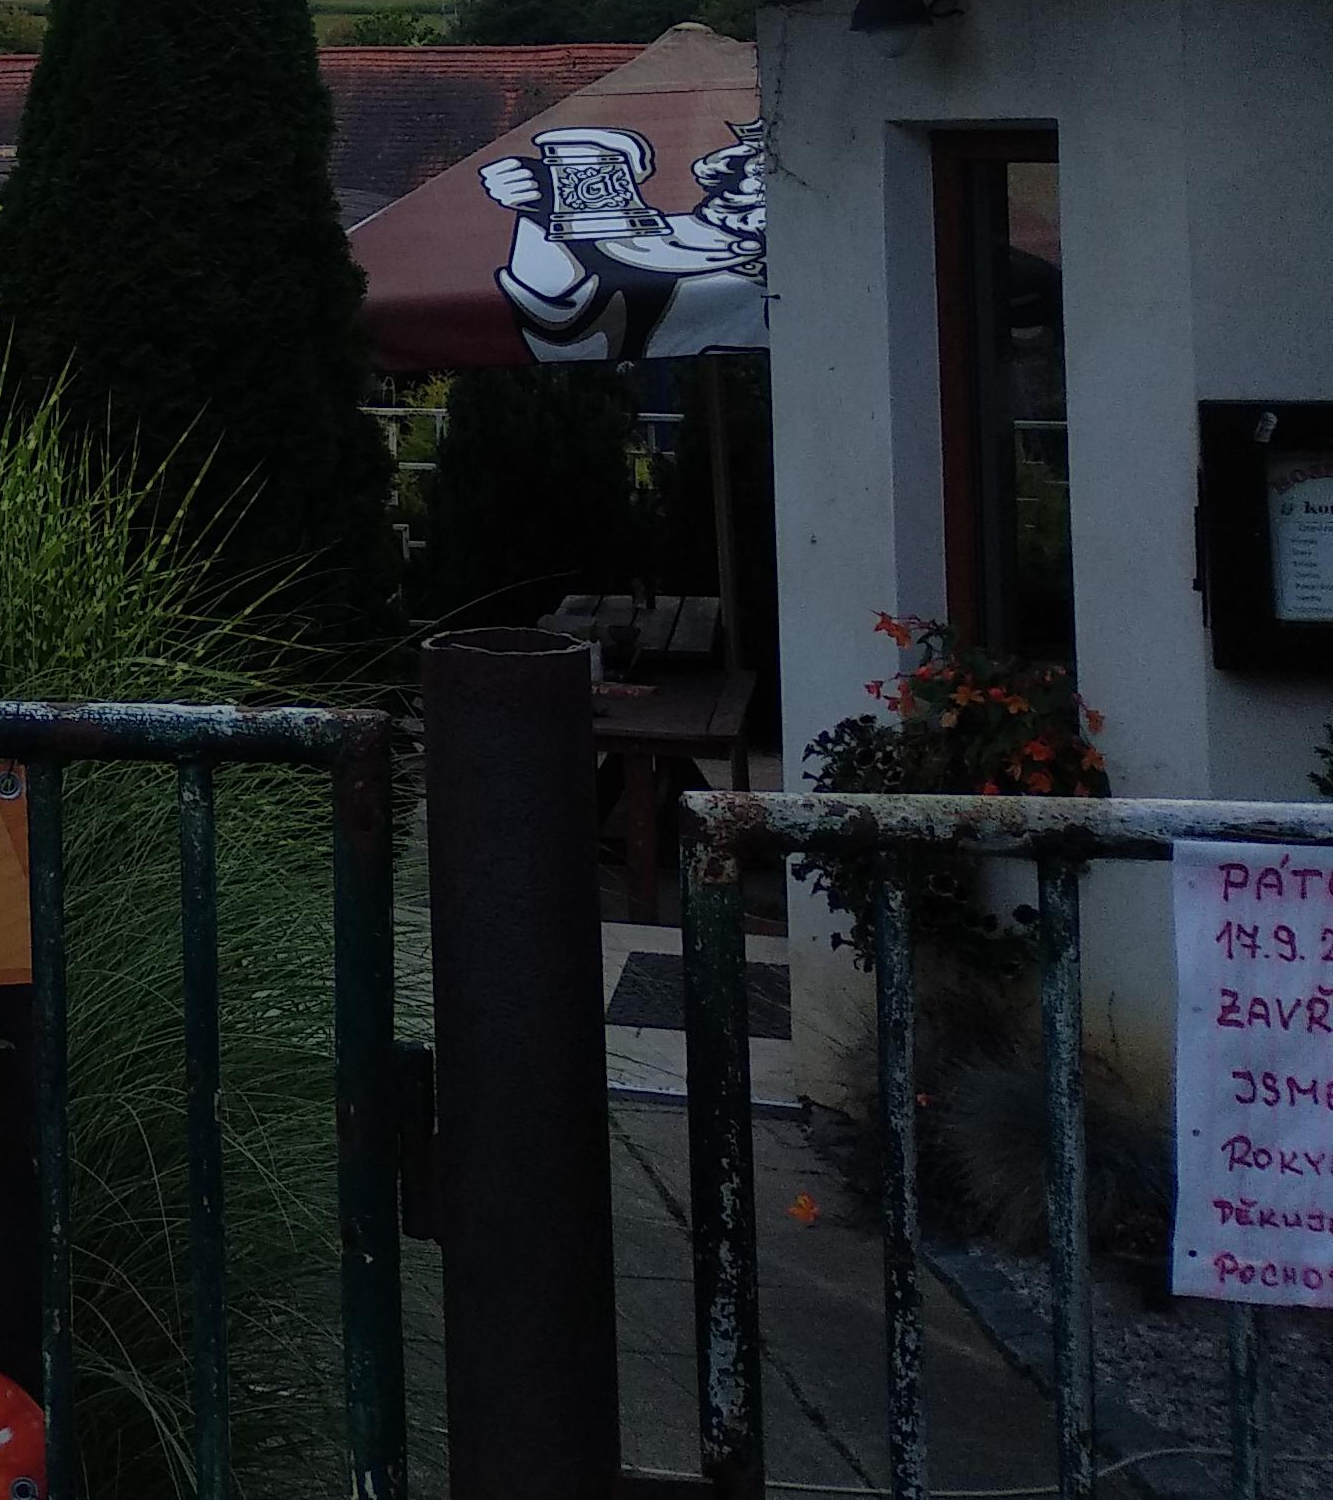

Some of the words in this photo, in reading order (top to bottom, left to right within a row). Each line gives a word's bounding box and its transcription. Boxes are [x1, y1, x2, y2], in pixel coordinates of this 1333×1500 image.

[1219, 853, 1333, 902] PÁT
[1221, 1134, 1333, 1177] ROKY
[1214, 1251, 1333, 1290] POCHO
